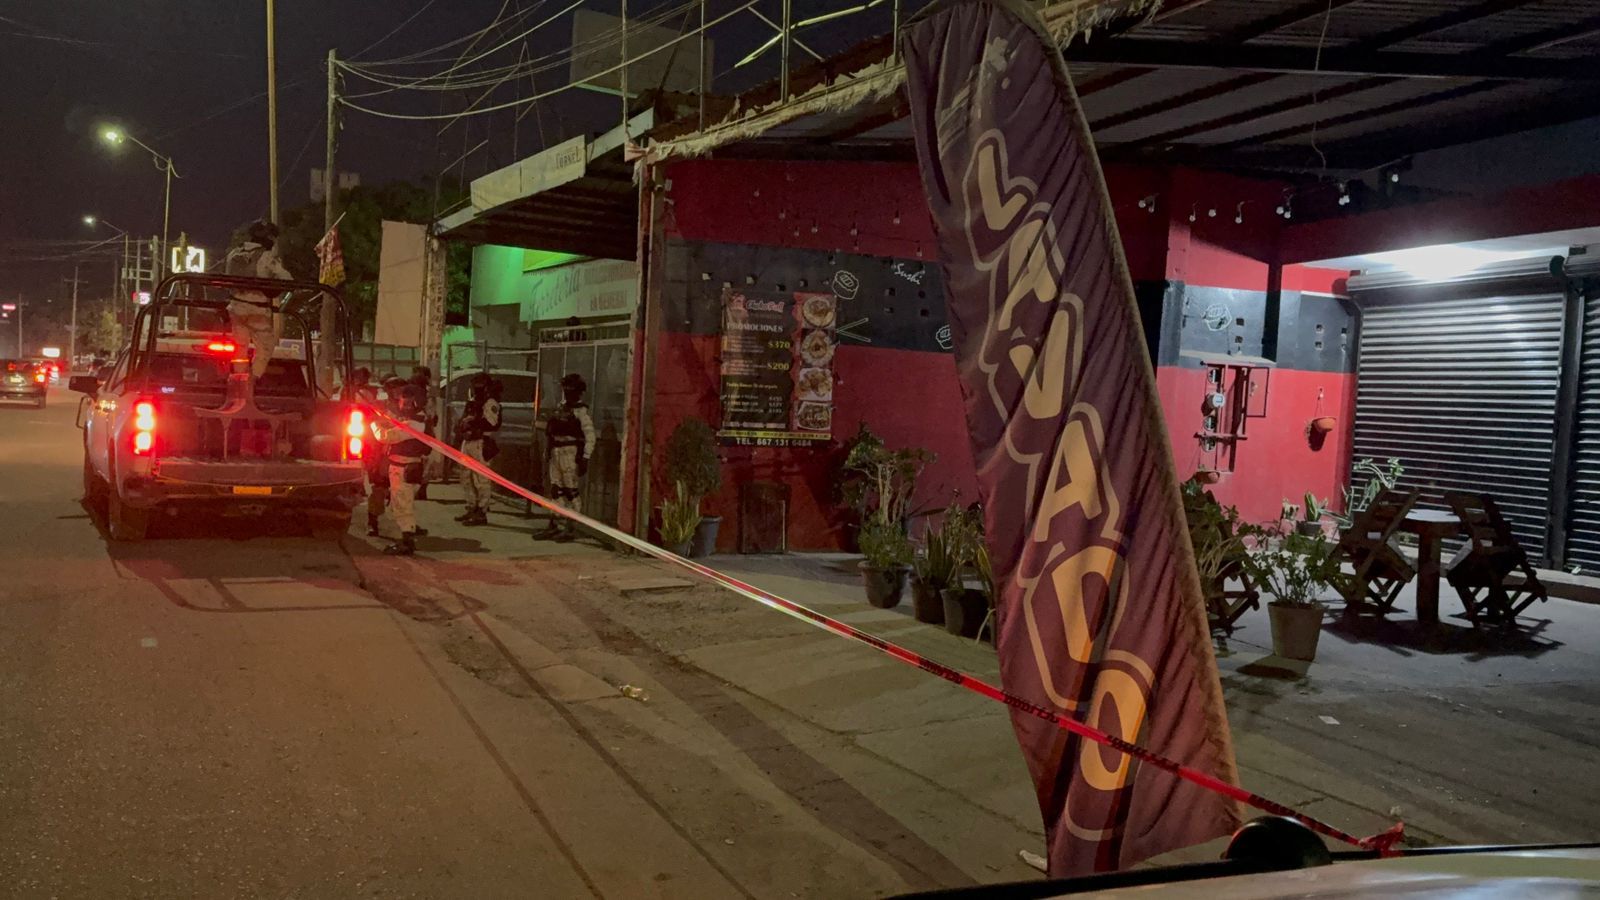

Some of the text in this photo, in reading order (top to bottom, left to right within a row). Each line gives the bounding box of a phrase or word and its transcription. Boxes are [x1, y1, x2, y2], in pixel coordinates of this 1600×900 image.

[894, 263, 922, 285] Sushi
[768, 340, 791, 350] $370
[767, 362, 790, 371] $200
[736, 437, 753, 446] TEL.
[756, 438, 771, 446] 667
[775, 438, 789, 447] 131
[968, 136, 1150, 796] LAVADO
